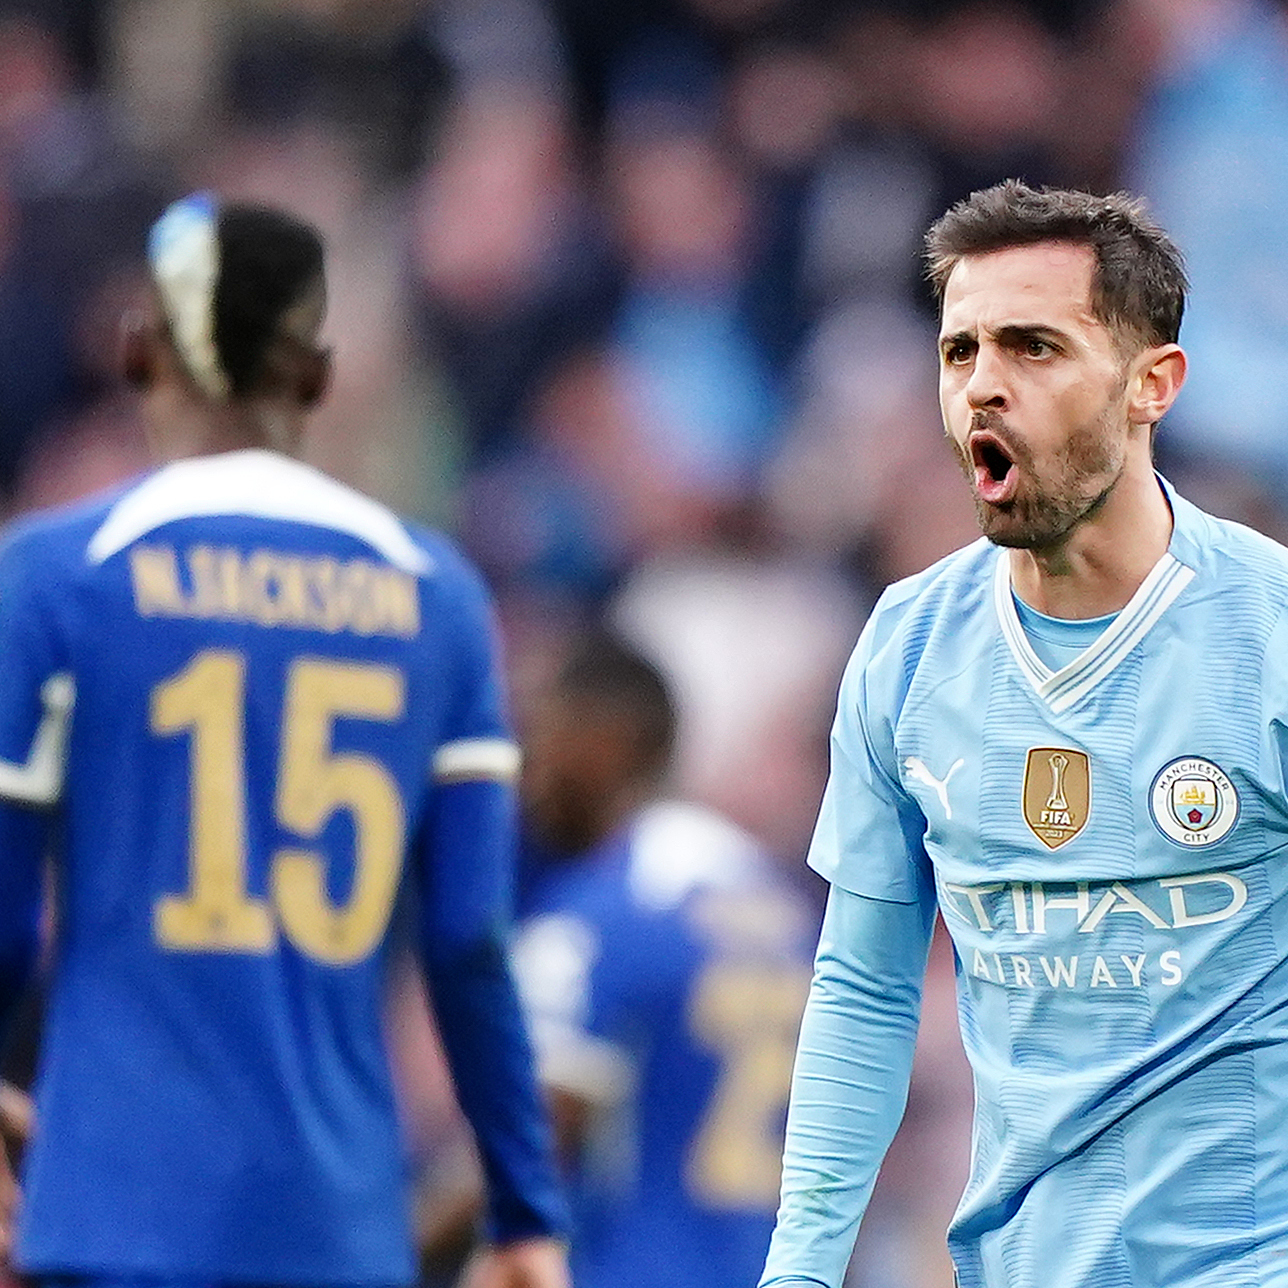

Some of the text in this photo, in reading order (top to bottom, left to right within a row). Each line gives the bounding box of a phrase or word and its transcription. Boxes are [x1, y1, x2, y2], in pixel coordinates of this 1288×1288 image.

[1159, 762, 1230, 791] MANCHESTER
[149, 648, 410, 968] 15
[1040, 810, 1072, 826] FIFA
[1183, 832, 1210, 842] CITY
[973, 947, 1182, 989] AIRWAYS
